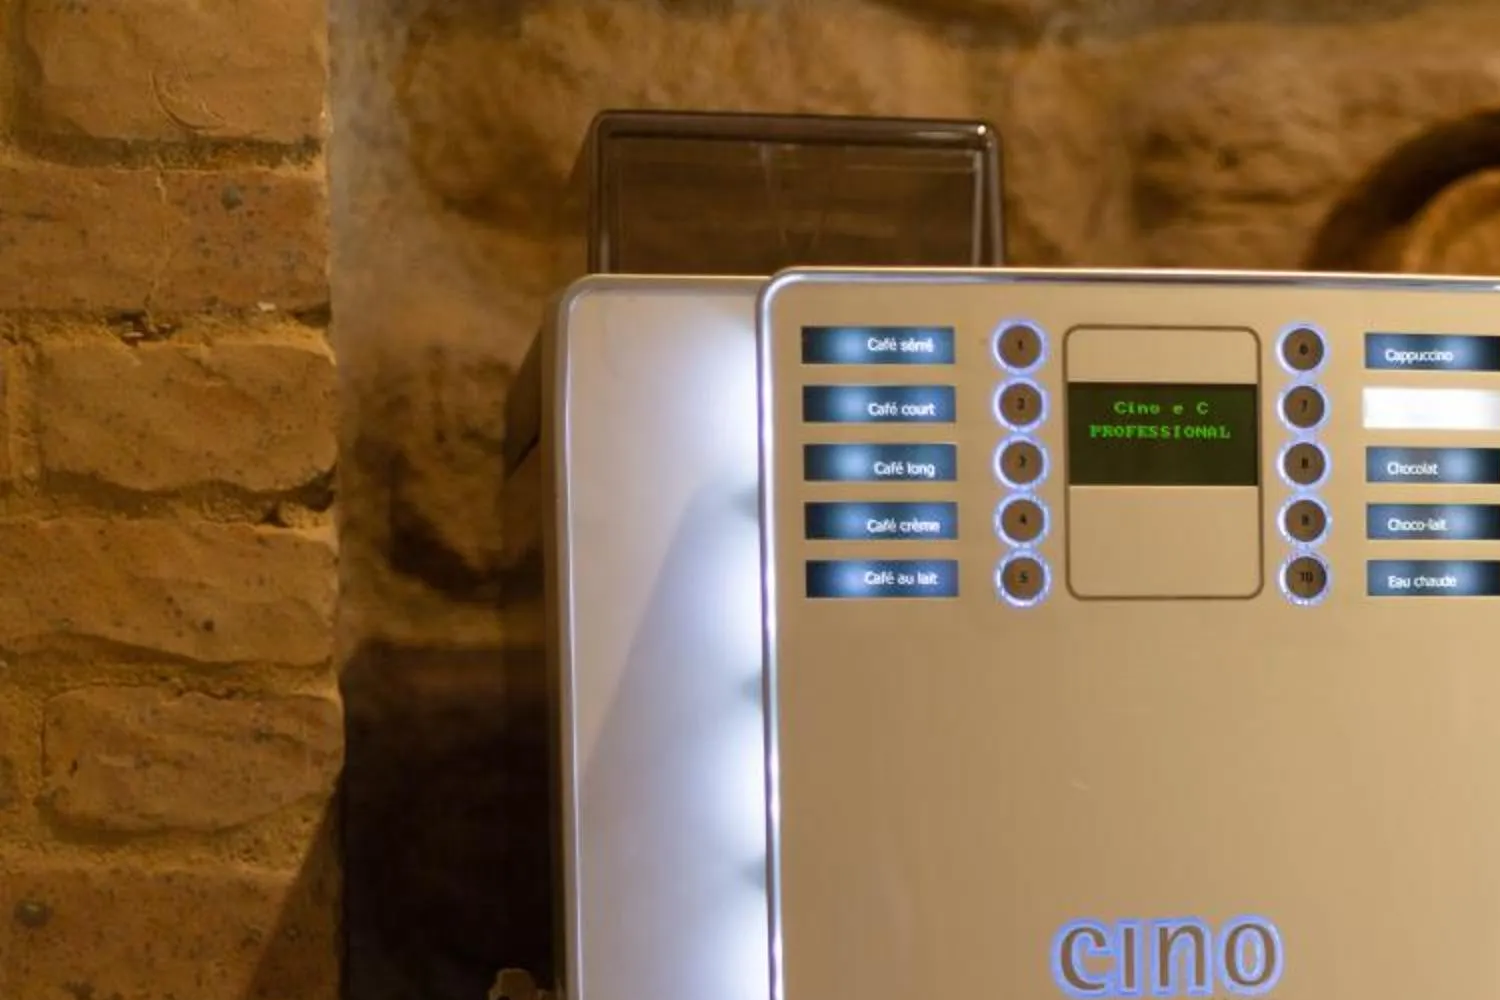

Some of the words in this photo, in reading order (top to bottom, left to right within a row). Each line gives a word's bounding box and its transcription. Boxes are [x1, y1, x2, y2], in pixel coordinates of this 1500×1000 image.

[867, 337, 897, 351] Café
[1385, 349, 1454, 363] Cappuccino
[868, 402, 897, 416] Café
[901, 404, 936, 416] court
[1113, 401, 1160, 415] Cino
[1172, 404, 1184, 415] e
[1089, 424, 1232, 439] PROFESSIONAL
[873, 462, 904, 476] Café
[907, 463, 935, 478] long
[1387, 461, 1438, 475] Chocolat
[866, 519, 897, 532] Café
[900, 518, 941, 532] crème
[864, 571, 894, 585] Café
[898, 574, 914, 585] au
[917, 571, 938, 585] lait
[1300, 571, 1315, 584] 10
[1387, 575, 1411, 588] Eau
[1413, 575, 1457, 587] chaude
